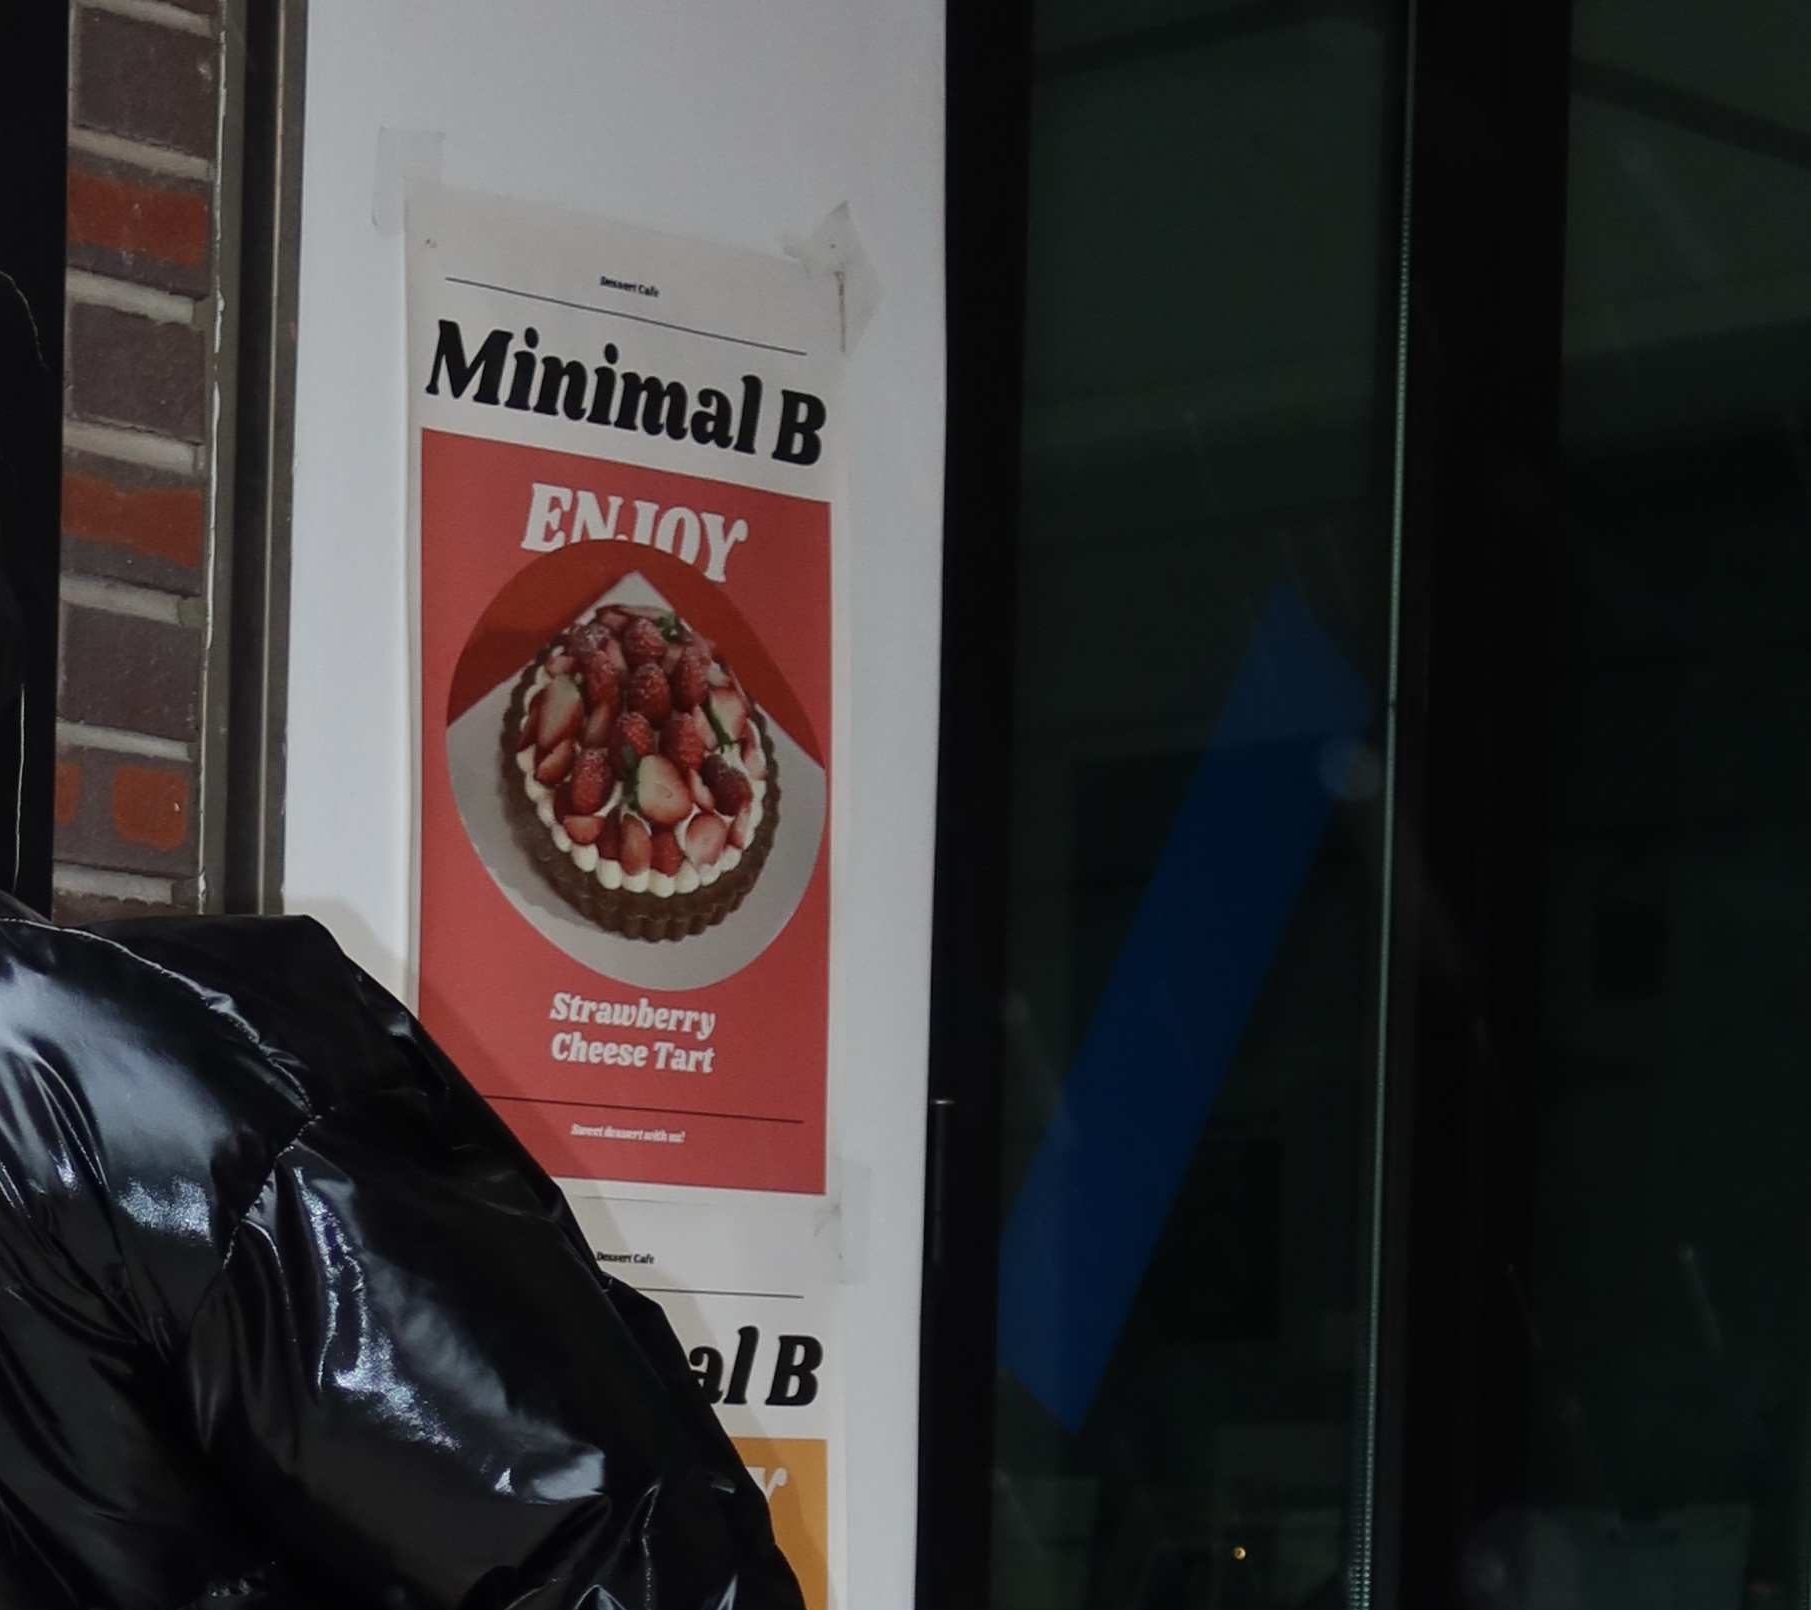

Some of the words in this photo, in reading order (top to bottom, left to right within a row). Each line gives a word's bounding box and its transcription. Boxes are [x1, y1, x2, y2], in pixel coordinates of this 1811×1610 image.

[425, 319, 763, 454] Minimal
[772, 389, 827, 466] B
[520, 482, 749, 584] ENJOY
[548, 991, 717, 1041] Strawberry
[551, 1031, 650, 1068] Cheese
[653, 1041, 717, 1074] Tart
[571, 1123, 604, 1137] Sweet
[604, 1126, 644, 1141] dessert
[644, 1129, 668, 1142] with
[764, 1335, 824, 1407] B
